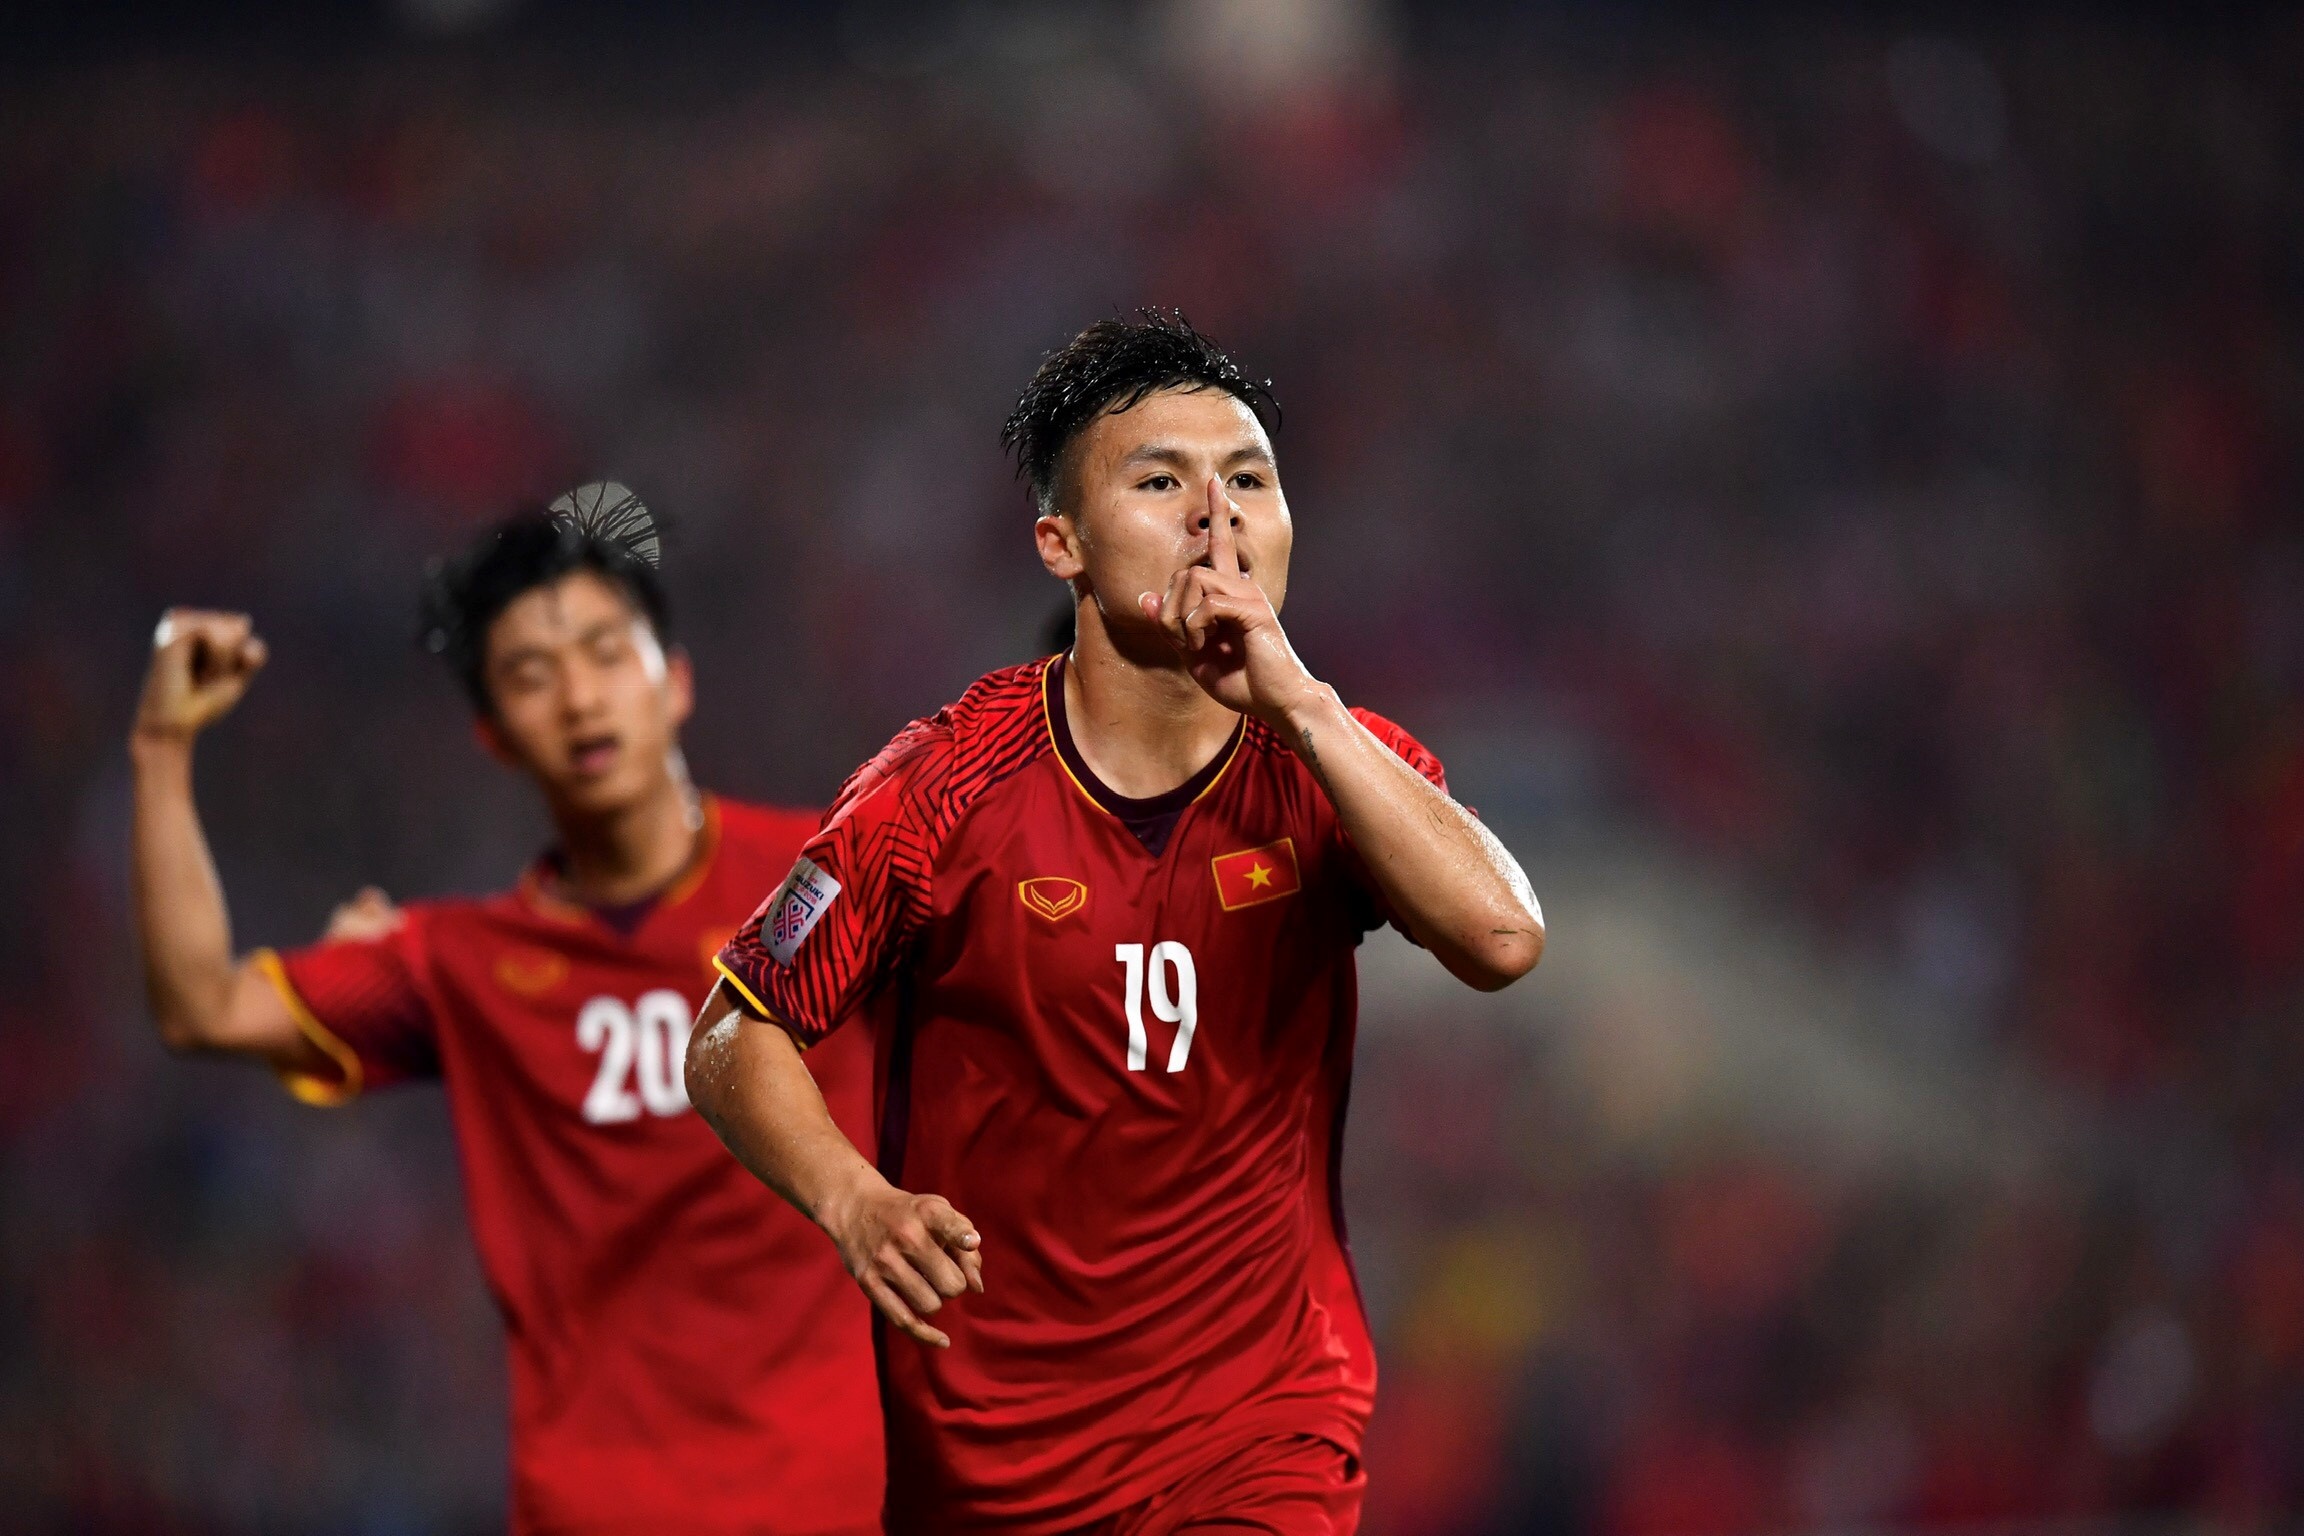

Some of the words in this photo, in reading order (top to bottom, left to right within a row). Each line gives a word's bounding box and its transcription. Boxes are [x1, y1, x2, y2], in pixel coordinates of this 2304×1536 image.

[795, 874, 825, 901] SUZUKI
[576, 988, 692, 1123] 20
[1115, 940, 1198, 1073] 19
